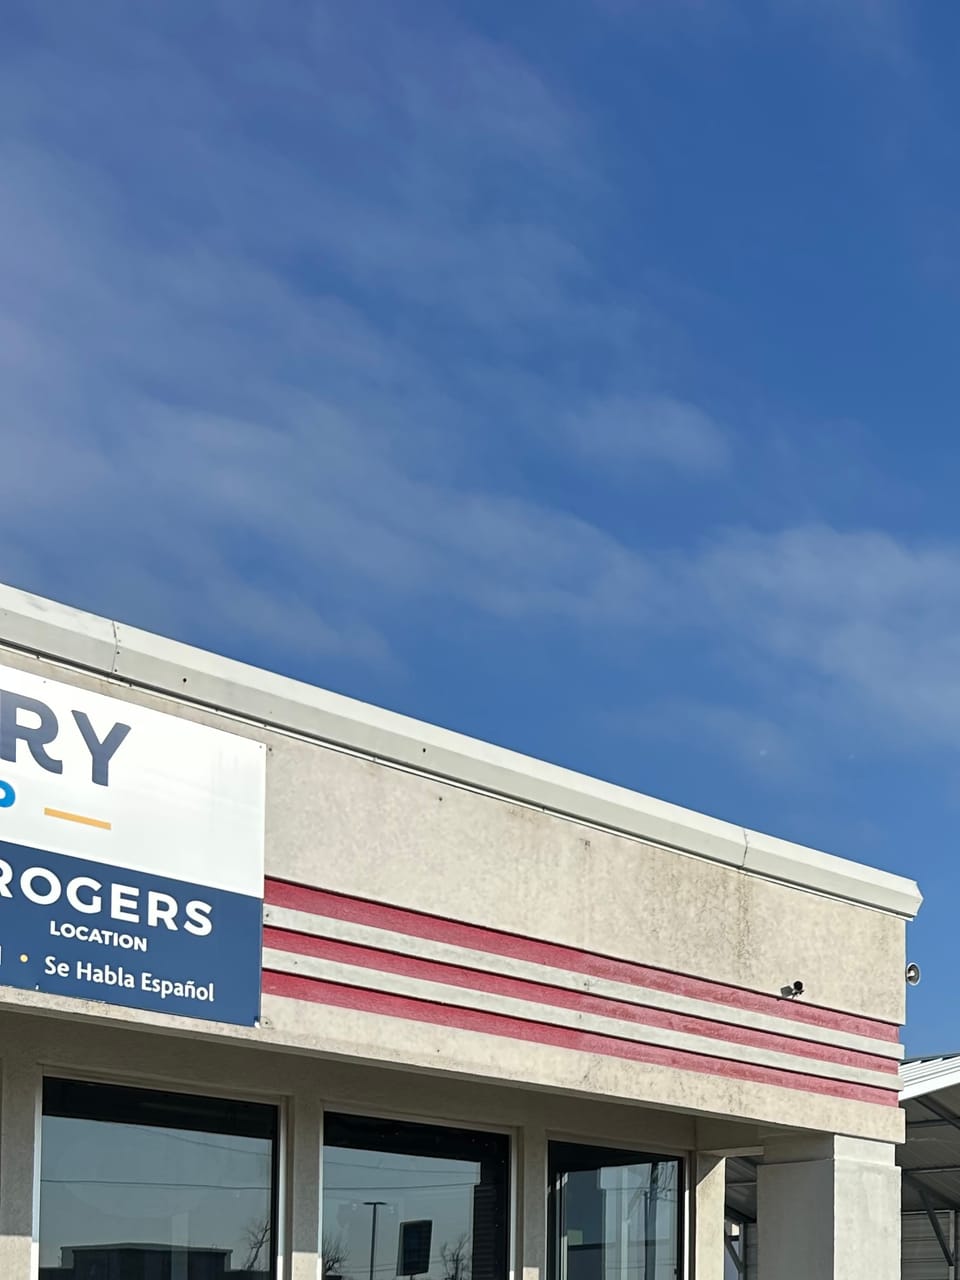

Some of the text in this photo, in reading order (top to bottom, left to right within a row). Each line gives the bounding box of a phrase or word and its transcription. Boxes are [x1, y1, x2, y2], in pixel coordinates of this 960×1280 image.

[50, 920, 148, 952] LOCATION
[45, 956, 215, 1002] Se Habla Español
